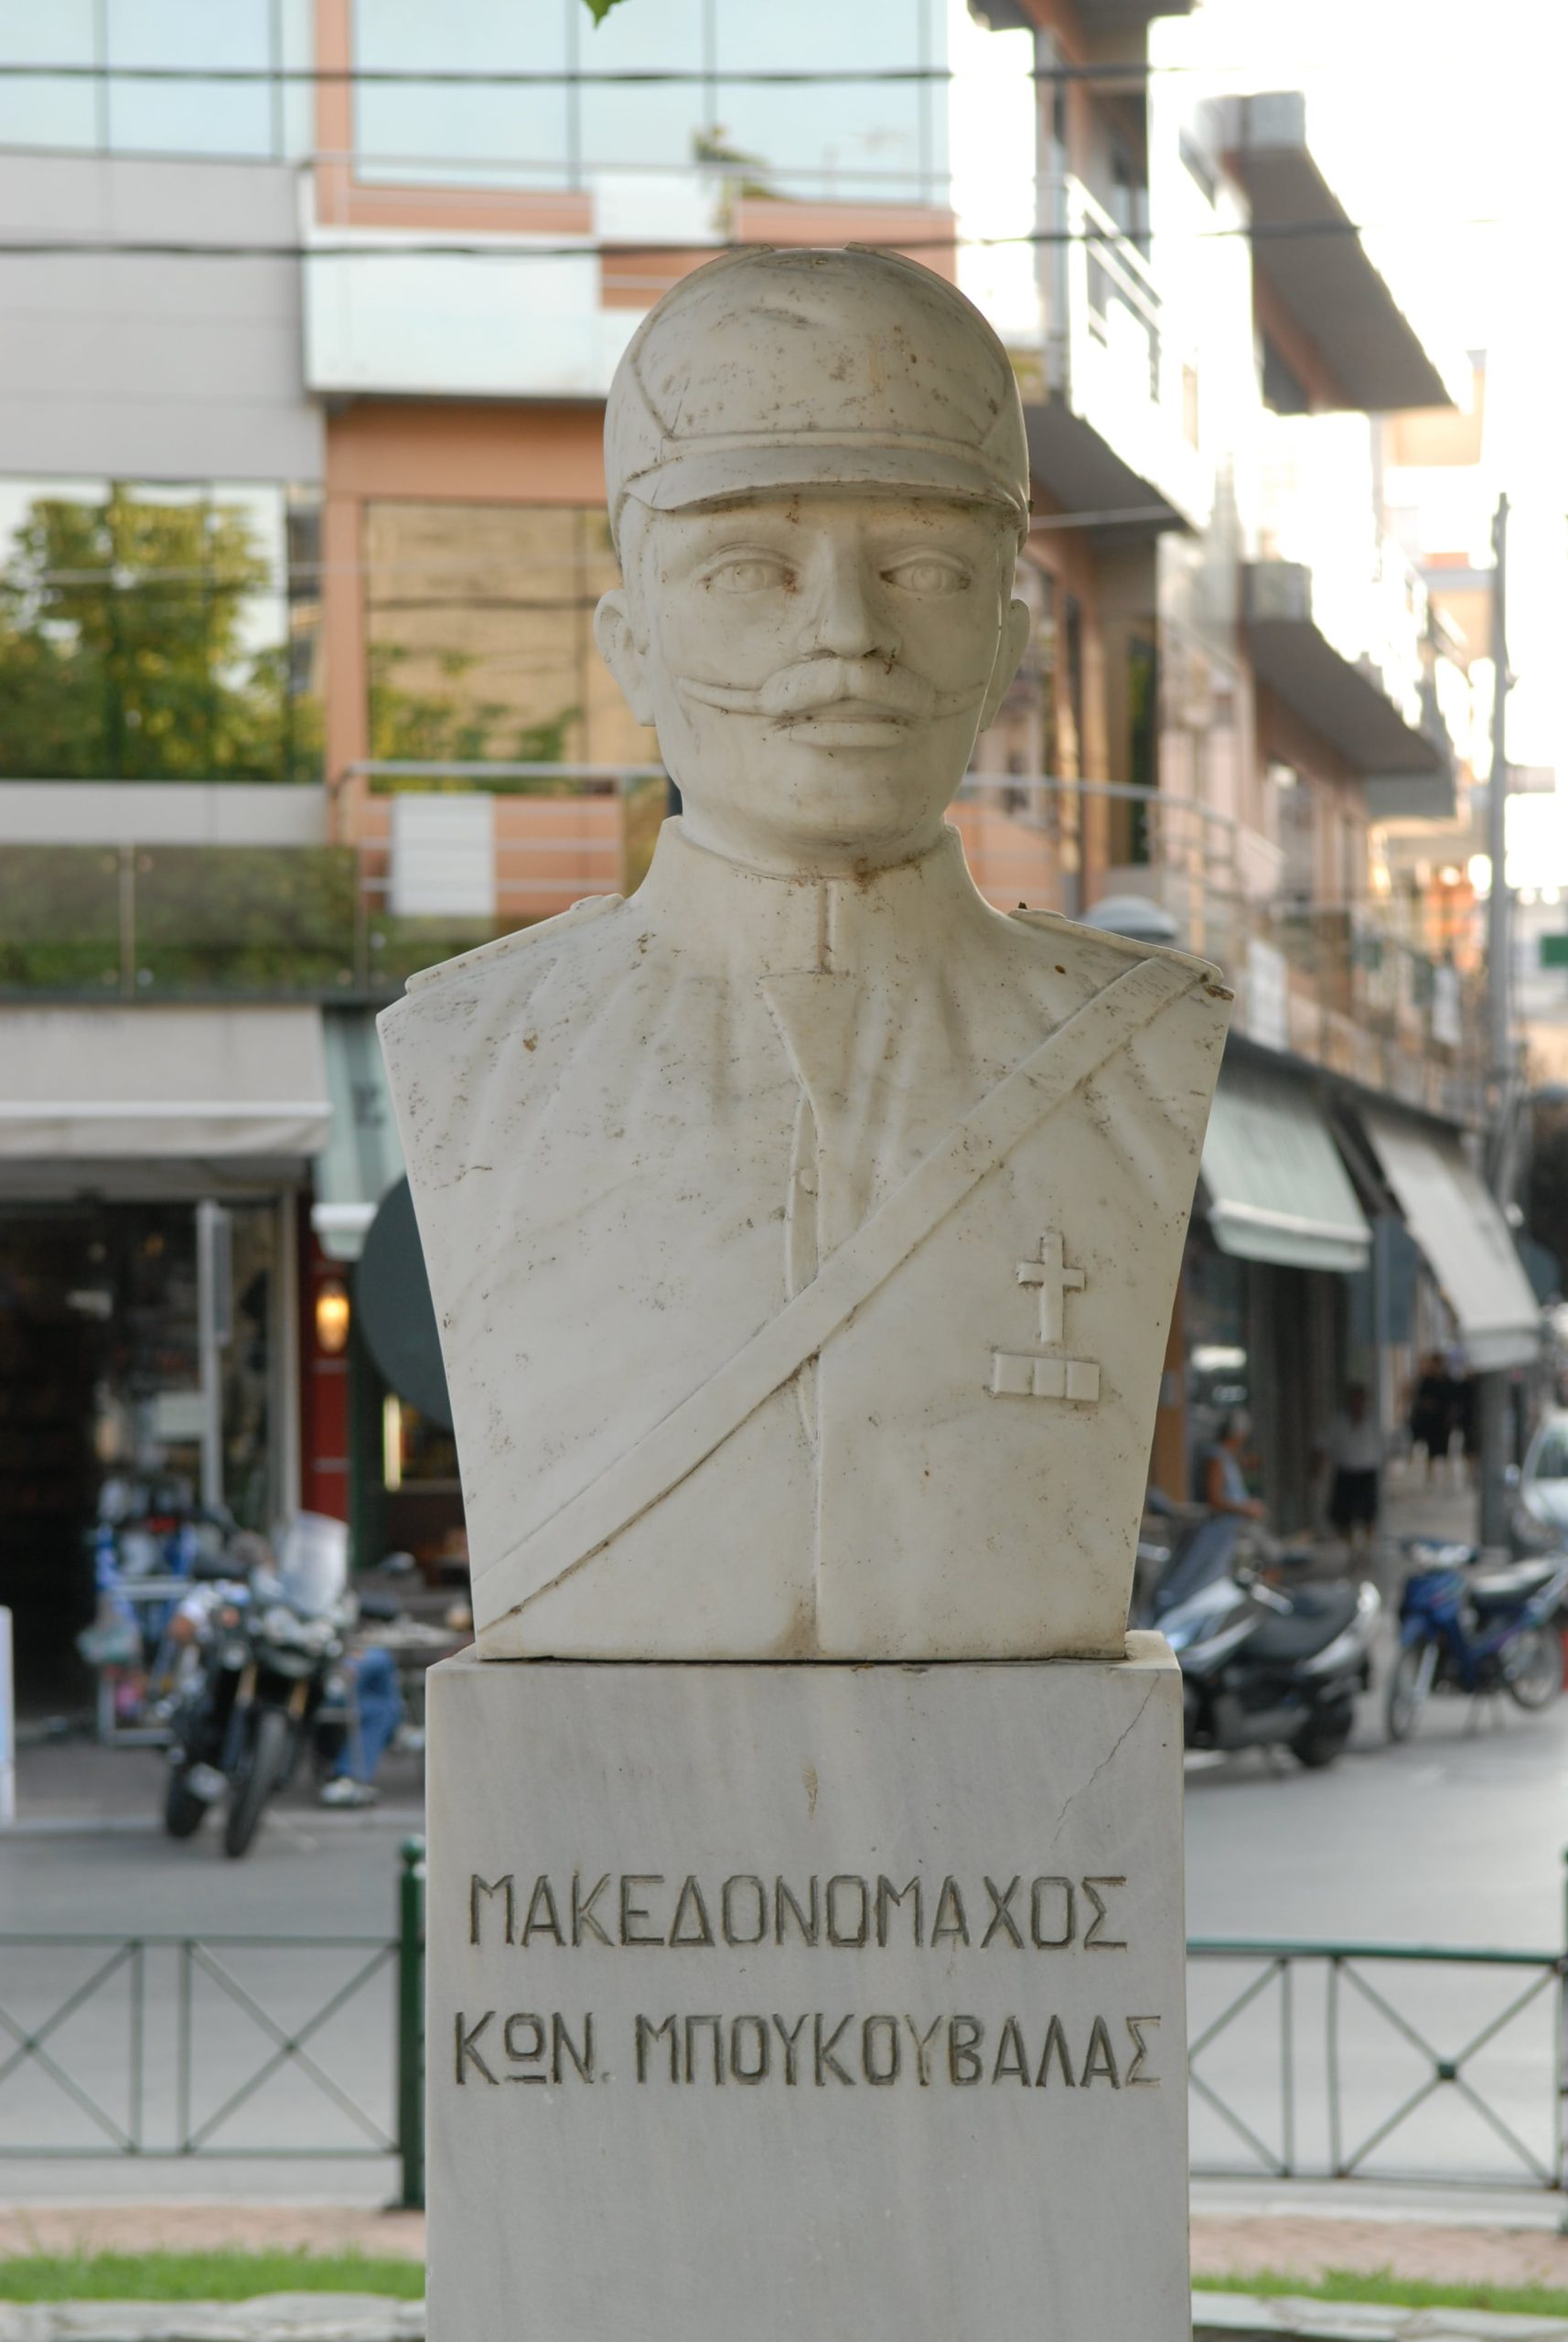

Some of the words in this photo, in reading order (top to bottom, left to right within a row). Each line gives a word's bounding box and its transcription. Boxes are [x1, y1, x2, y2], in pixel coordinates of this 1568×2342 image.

[470, 1874, 1128, 1950] ΜΑΚΕΔΟΝΟΜΑΧΟΣ
[455, 2011, 613, 2086] ΚΩΝ.
[635, 2013, 1162, 2089] ΜΠΟΥΚΟΥΒΑΛΑΣ
